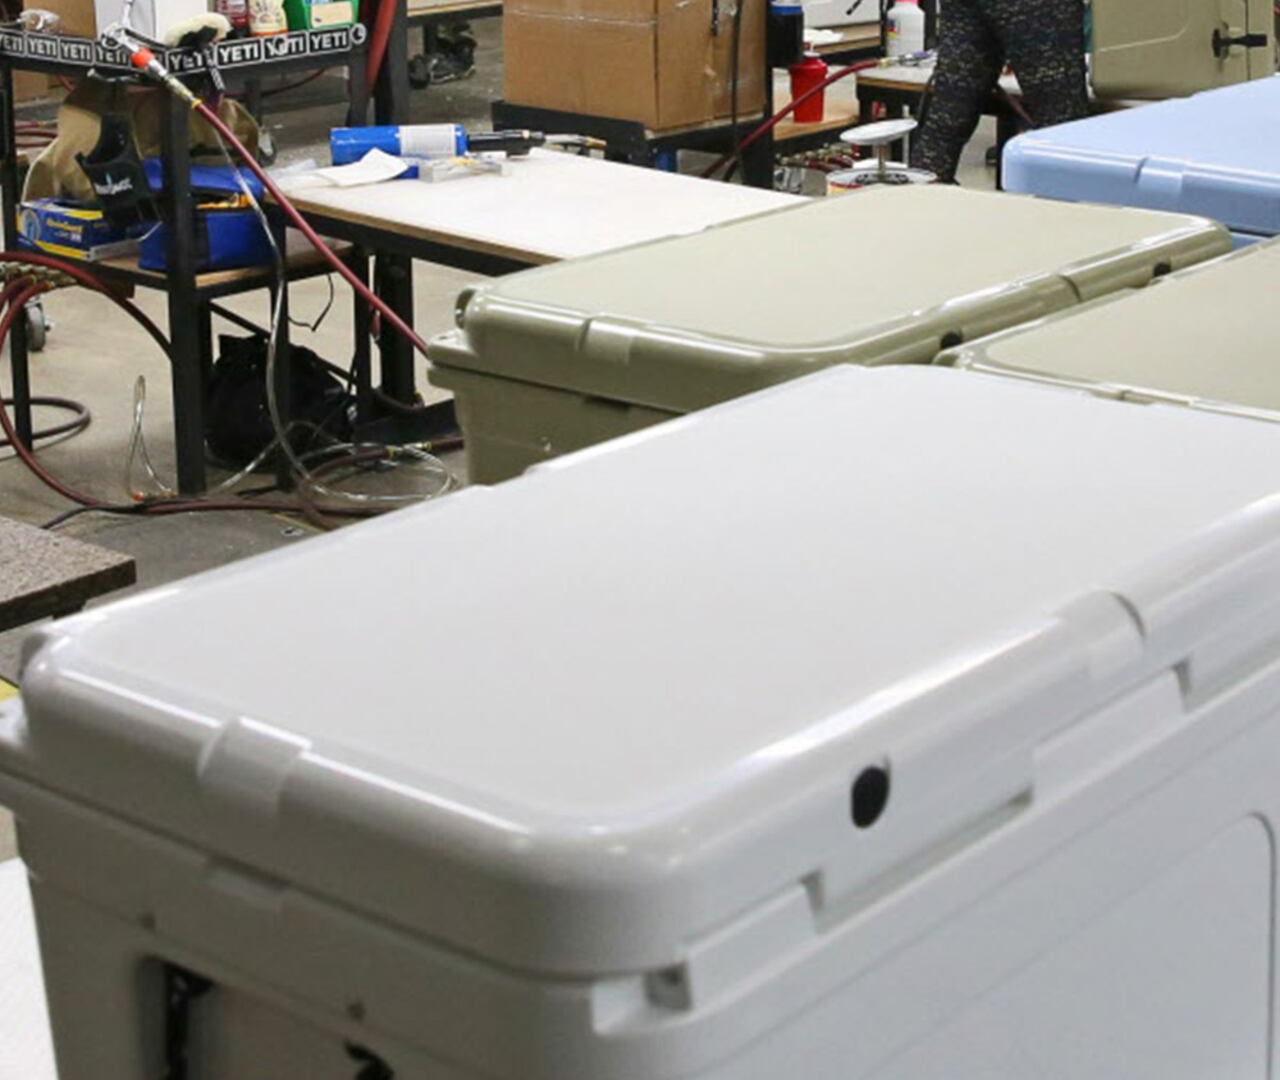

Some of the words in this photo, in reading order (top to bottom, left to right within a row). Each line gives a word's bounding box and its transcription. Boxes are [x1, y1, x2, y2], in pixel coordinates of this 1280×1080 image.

[28, 37, 57, 57] YETI
[311, 32, 348, 50] YETI
[61, 42, 91, 61] YETI
[219, 42, 258, 63] YETI
